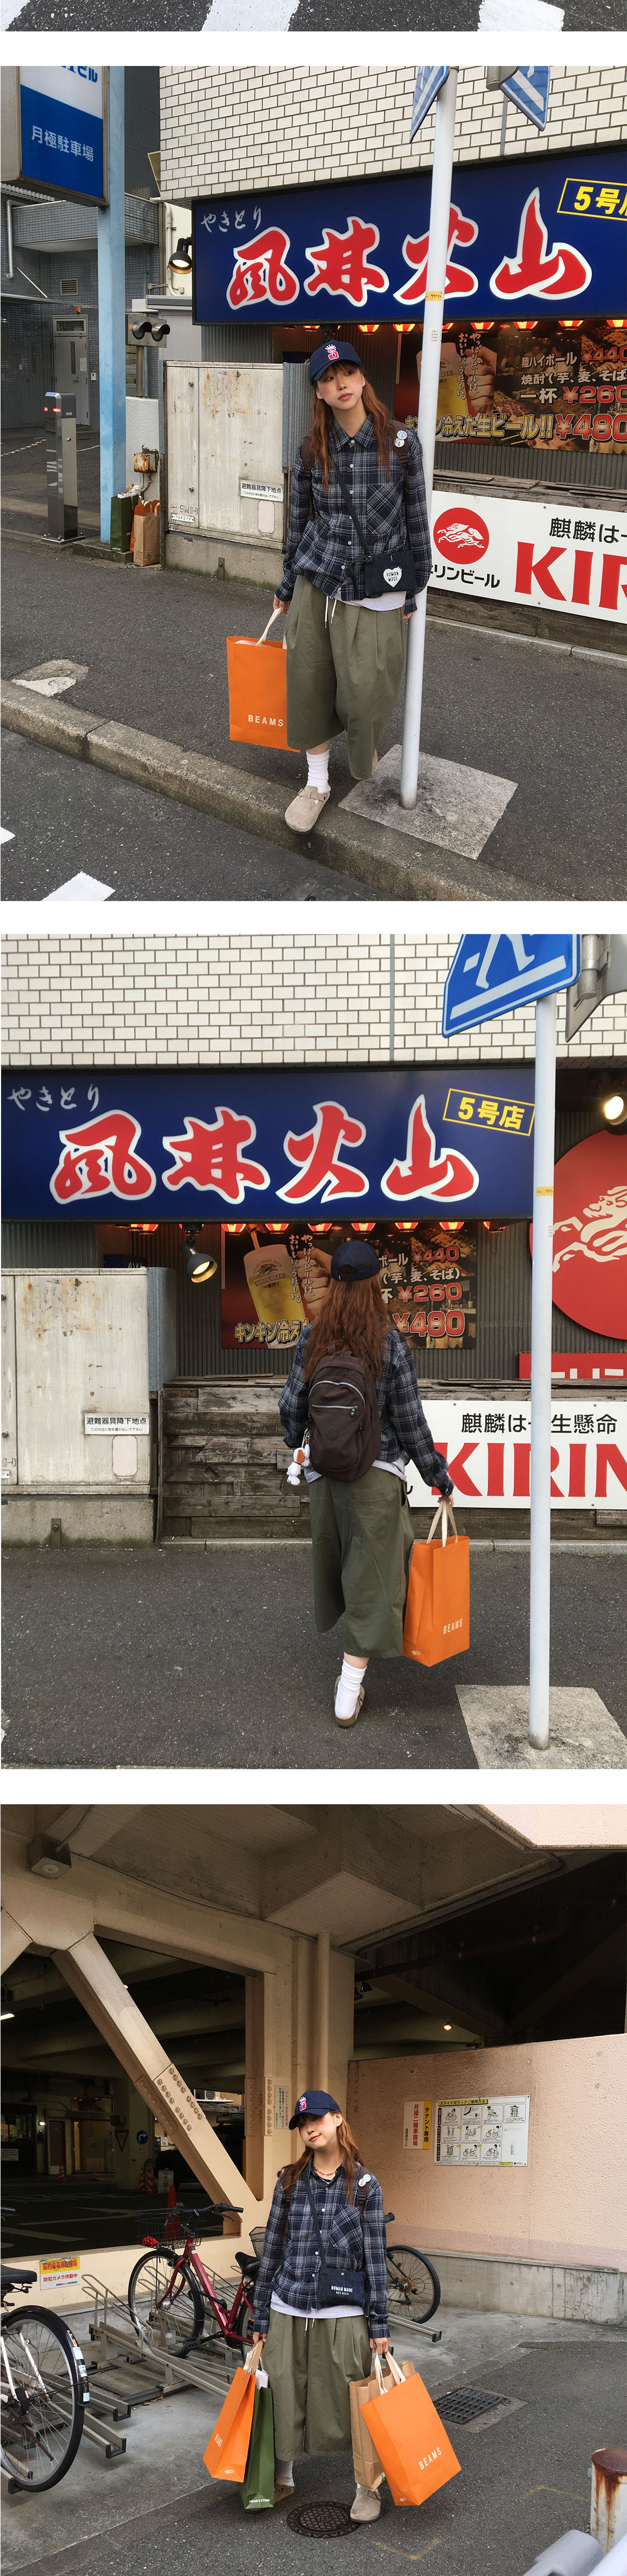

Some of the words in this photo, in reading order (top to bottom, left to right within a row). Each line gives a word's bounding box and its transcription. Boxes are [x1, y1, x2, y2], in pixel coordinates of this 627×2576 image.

[31, 125, 94, 162] 月極駐車場
[201, 205, 261, 233] やきとり
[226, 187, 592, 310] 風林火山
[522, 352, 577, 368] 陸ハイボール
[520, 388, 557, 403] 一杯
[242, 483, 282, 494] 避難器具降下地点
[248, 714, 283, 727] BEAMS
[7, 1083, 99, 1112] やきとり
[458, 1097, 525, 1129] 5号店
[49, 1094, 480, 1205] 風林火山
[413, 1246, 459, 1263] ¥440
[256, 1277, 270, 1286] KIRIN
[397, 1283, 462, 1302] ¥260
[393, 1310, 465, 1337] ¥480
[461, 1413, 618, 1434] 麒麟は生懸命
[443, 1618, 463, 1635] BEAMS
[43, 2273, 78, 2282] 防犯カメラ作動中
[214, 2433, 223, 2448] BEAMS
[418, 2447, 442, 2470] BEAMS
